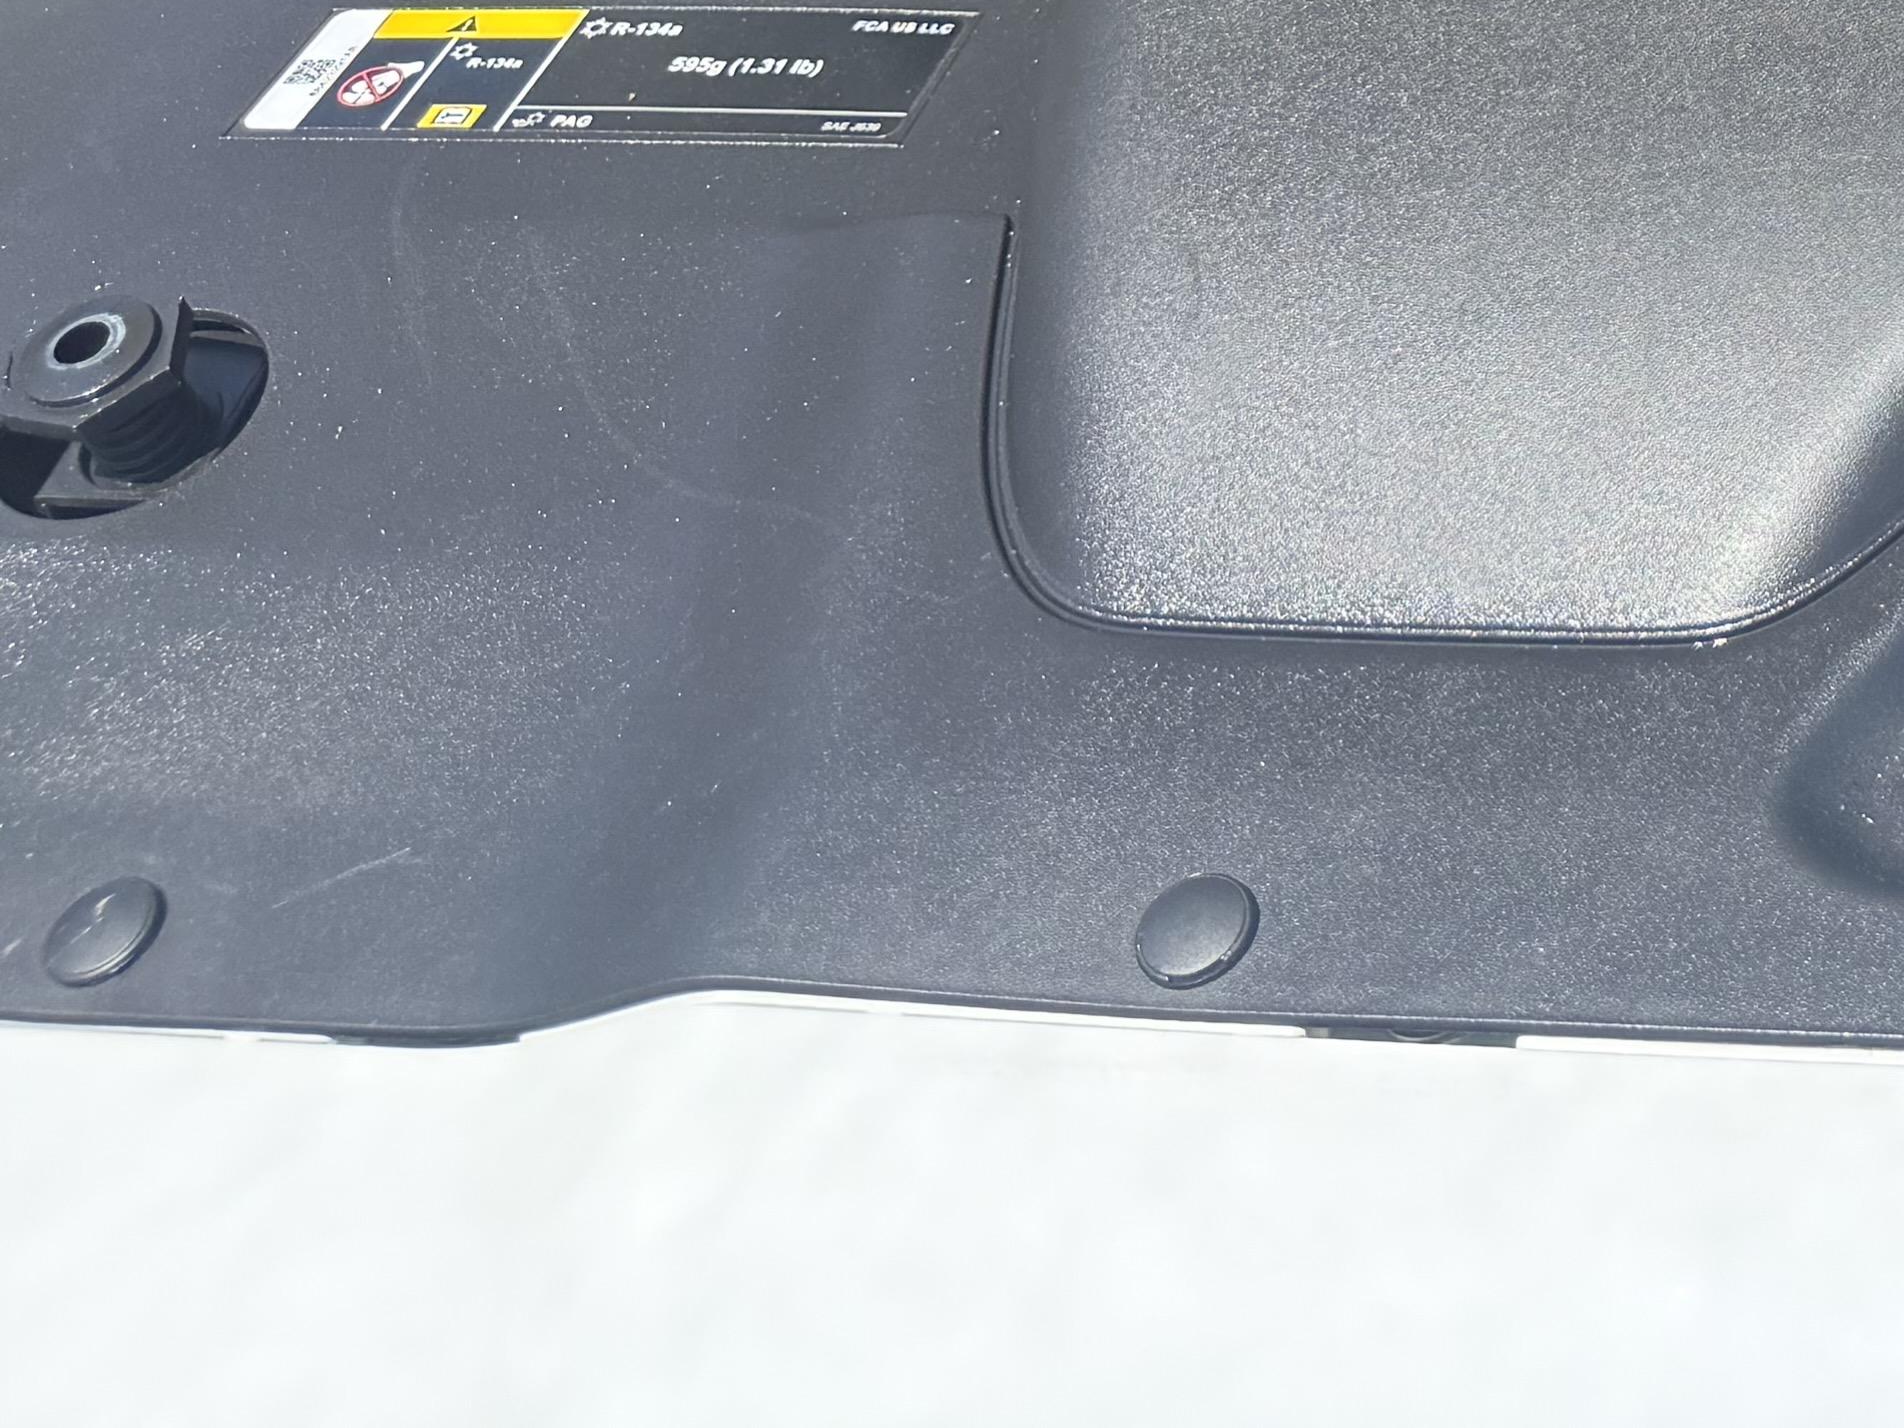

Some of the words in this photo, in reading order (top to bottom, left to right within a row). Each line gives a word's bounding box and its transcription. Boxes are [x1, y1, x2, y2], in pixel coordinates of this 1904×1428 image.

[610, 22, 683, 37] R-134a
[850, 20, 889, 33] FCA
[917, 22, 956, 35] LLC
[667, 56, 727, 77] 595g
[727, 57, 788, 77] (1.31
[788, 58, 824, 79] lb)
[550, 114, 593, 128] PAG
